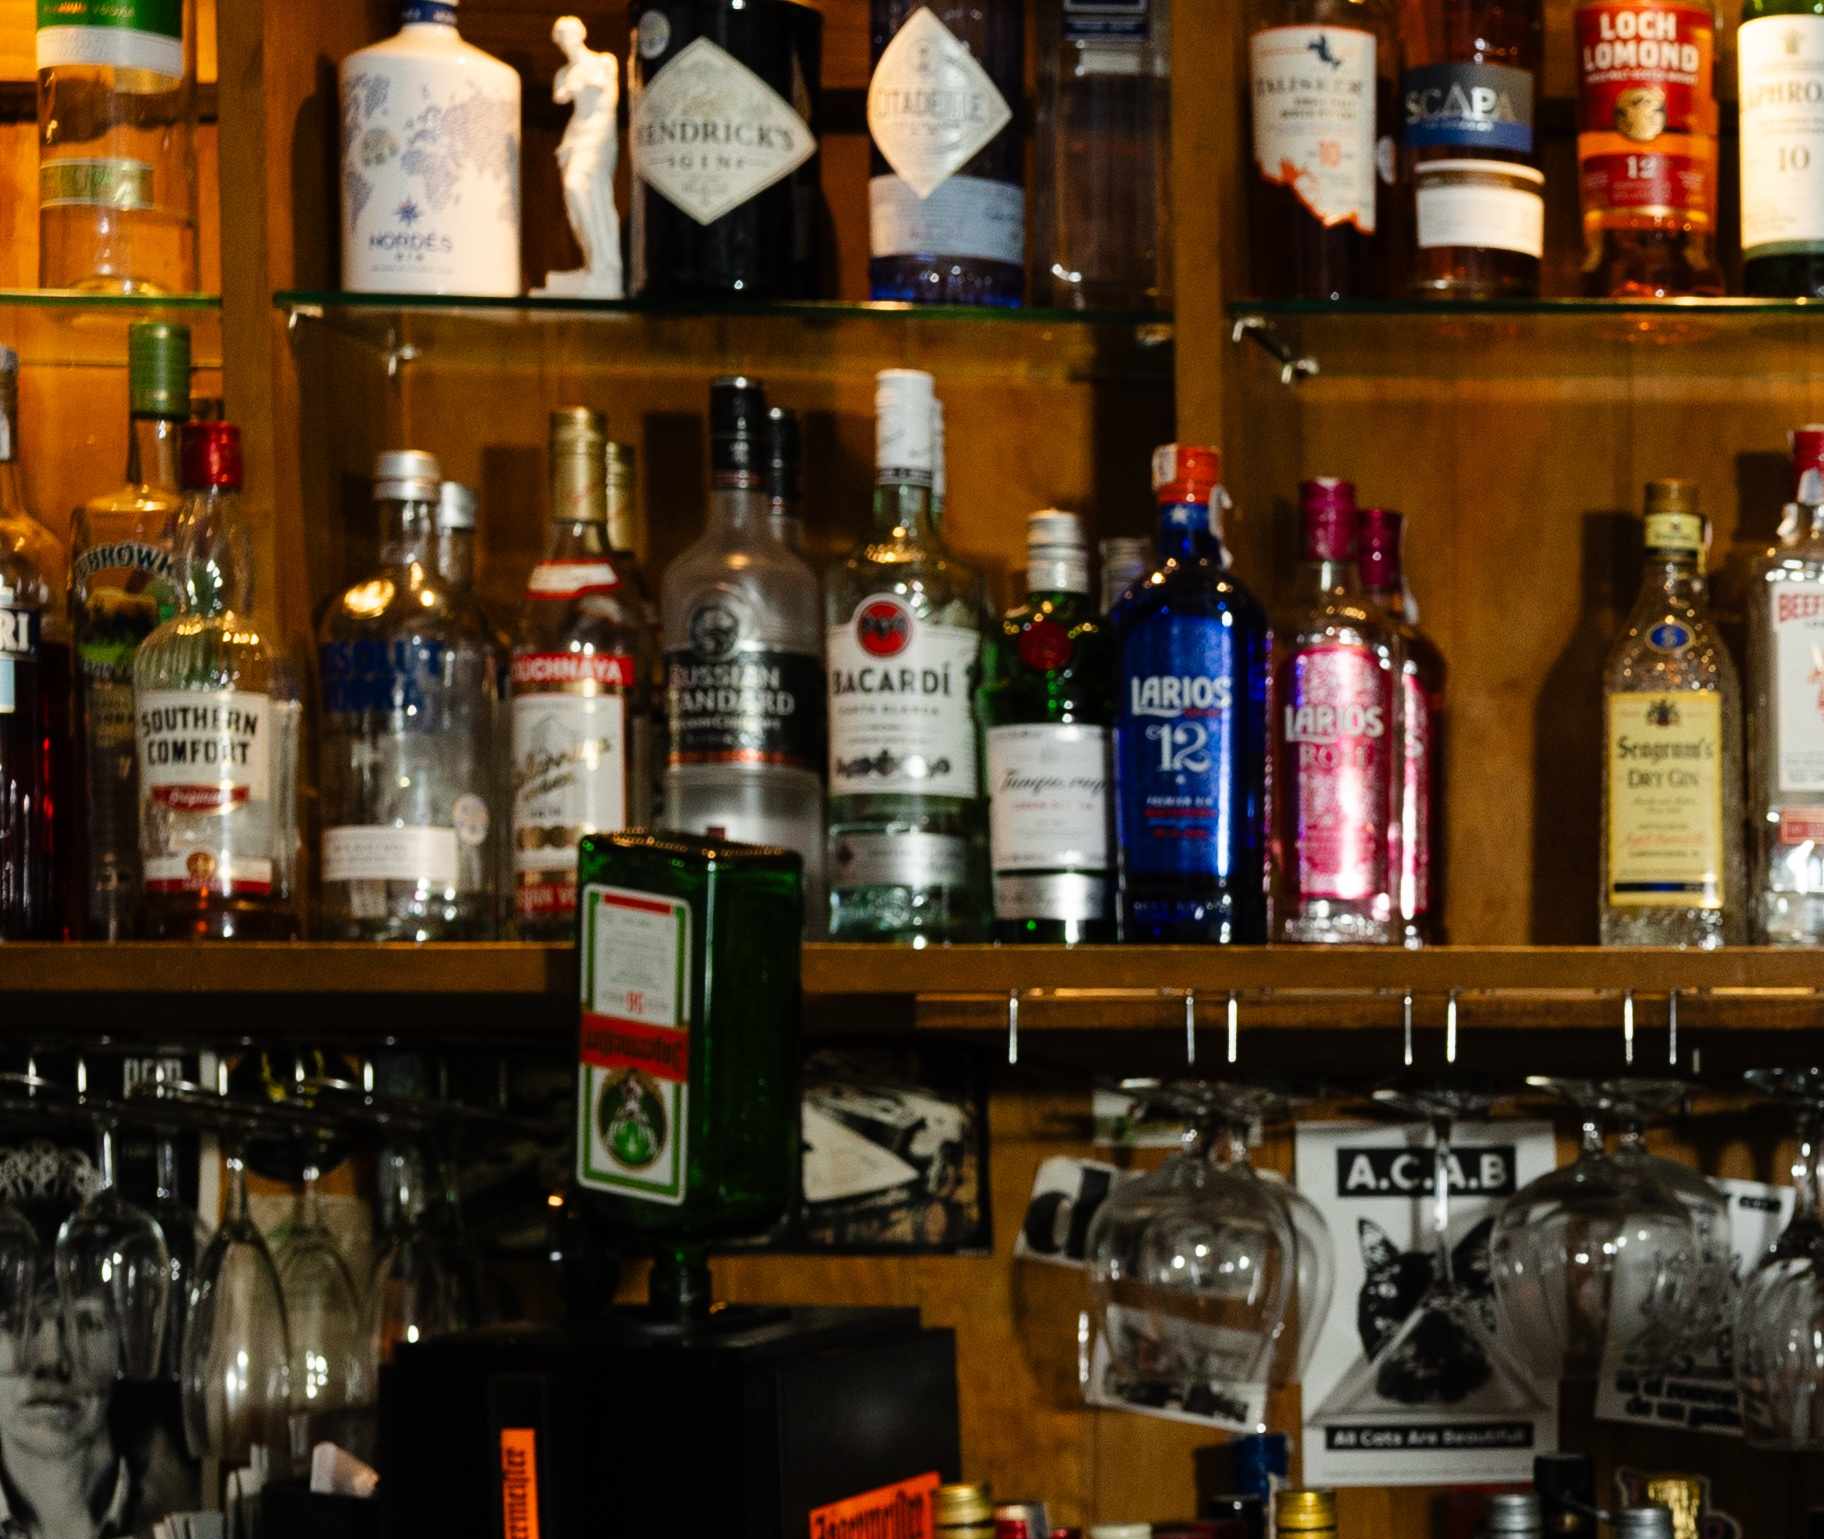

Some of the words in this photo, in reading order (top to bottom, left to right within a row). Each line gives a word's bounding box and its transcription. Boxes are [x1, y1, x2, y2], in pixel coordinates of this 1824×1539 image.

[1601, 11, 1677, 41] LOCH
[1584, 42, 1699, 71] LOMOND
[1405, 86, 1520, 122] SCAPA
[1131, 676, 1232, 717] LARIOS
[142, 706, 259, 737] SOUTHERN
[1285, 704, 1384, 744] LARIOS
[148, 738, 249, 765] COMFORT
[1157, 720, 1212, 775] 12
[1627, 767, 1664, 790] DRY
[1346, 1153, 1508, 1191] A.C.A.B
[1407, 1430, 1438, 1447] Are
